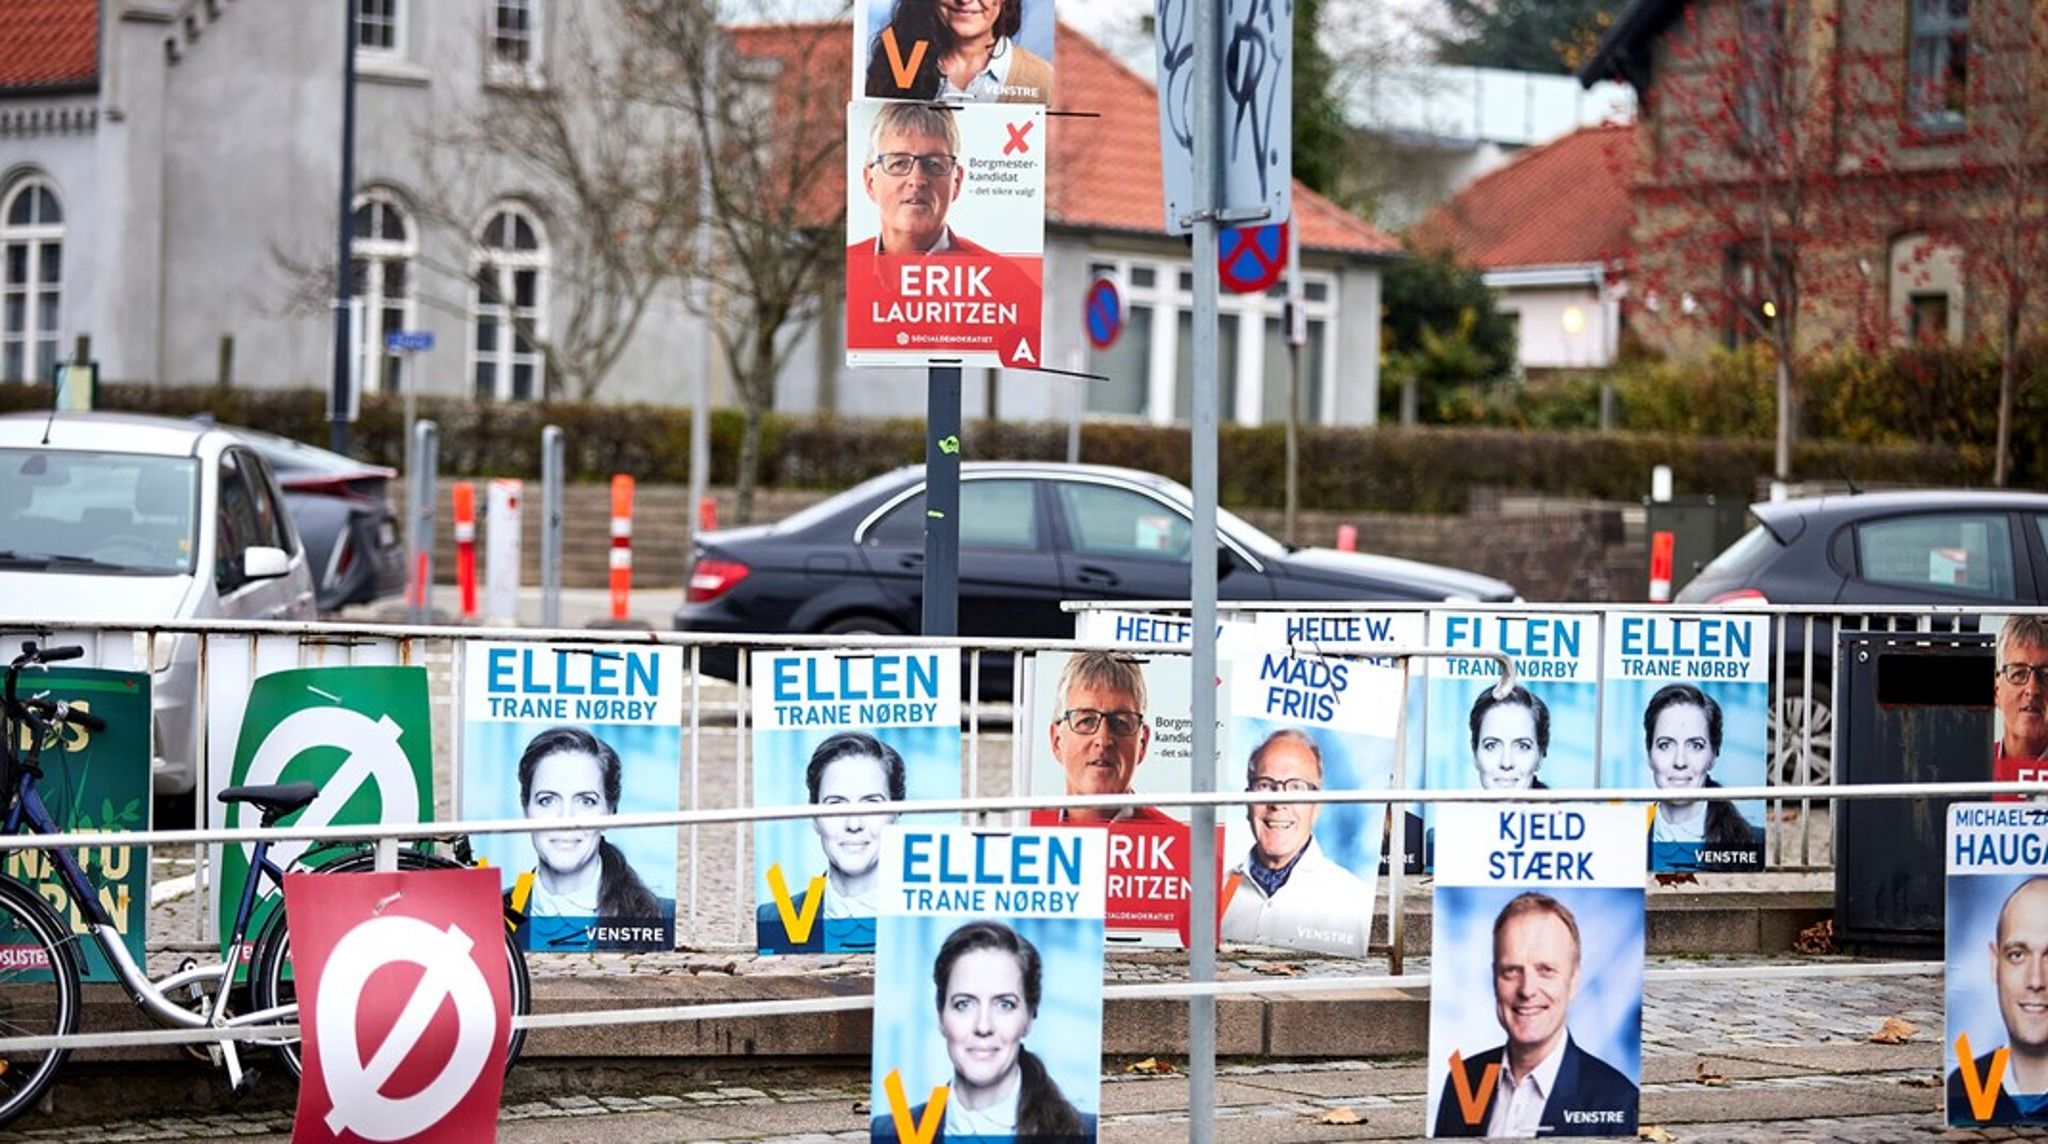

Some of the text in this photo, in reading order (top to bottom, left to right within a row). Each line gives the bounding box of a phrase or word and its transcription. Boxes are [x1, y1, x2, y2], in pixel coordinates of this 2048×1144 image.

[882, 26, 929, 88] V
[983, 82, 1040, 97] VENSTRE
[969, 158, 1038, 170] Borgmester-
[969, 171, 1018, 182] kandidat
[975, 187, 990, 196] det
[992, 187, 1013, 196] sikre
[900, 265, 993, 298] ERIK
[872, 301, 1018, 325] LAURITZEN
[911, 335, 993, 344] SOCIALDEMOKRATIET
[1011, 337, 1036, 363] A
[1287, 617, 1395, 641] HELLE W.
[1622, 618, 1751, 658] ELLEN
[487, 648, 660, 697] ELLEN
[773, 655, 938, 701] ELLEN
[1260, 653, 1348, 691] MADS
[1447, 658, 1578, 678] TRAN NØRBY
[1622, 659, 1751, 679] TRANE NØRBY
[488, 697, 658, 721] TRANE NØRBY
[774, 703, 938, 726] TRANE NØRBY
[1266, 686, 1335, 721] FRIIS
[1500, 811, 1586, 848] KJELD
[1955, 809, 2028, 827] MICHAEL
[902, 833, 1082, 885] ELLEN
[1109, 834, 1176, 870] RIK
[1694, 849, 1758, 863] VENSTRE
[1488, 851, 1595, 881] STÆRK
[766, 862, 827, 944] V
[903, 888, 1080, 913] TRANE NØRBY
[585, 925, 664, 943] VENSTRE
[1297, 926, 1355, 945] VENSTRE
[316, 914, 496, 1143] Ø
[1448, 1048, 1501, 1125] V
[1954, 1030, 2013, 1121] V
[883, 1067, 951, 1144] V
[1563, 1109, 1625, 1124] VENSTRE
